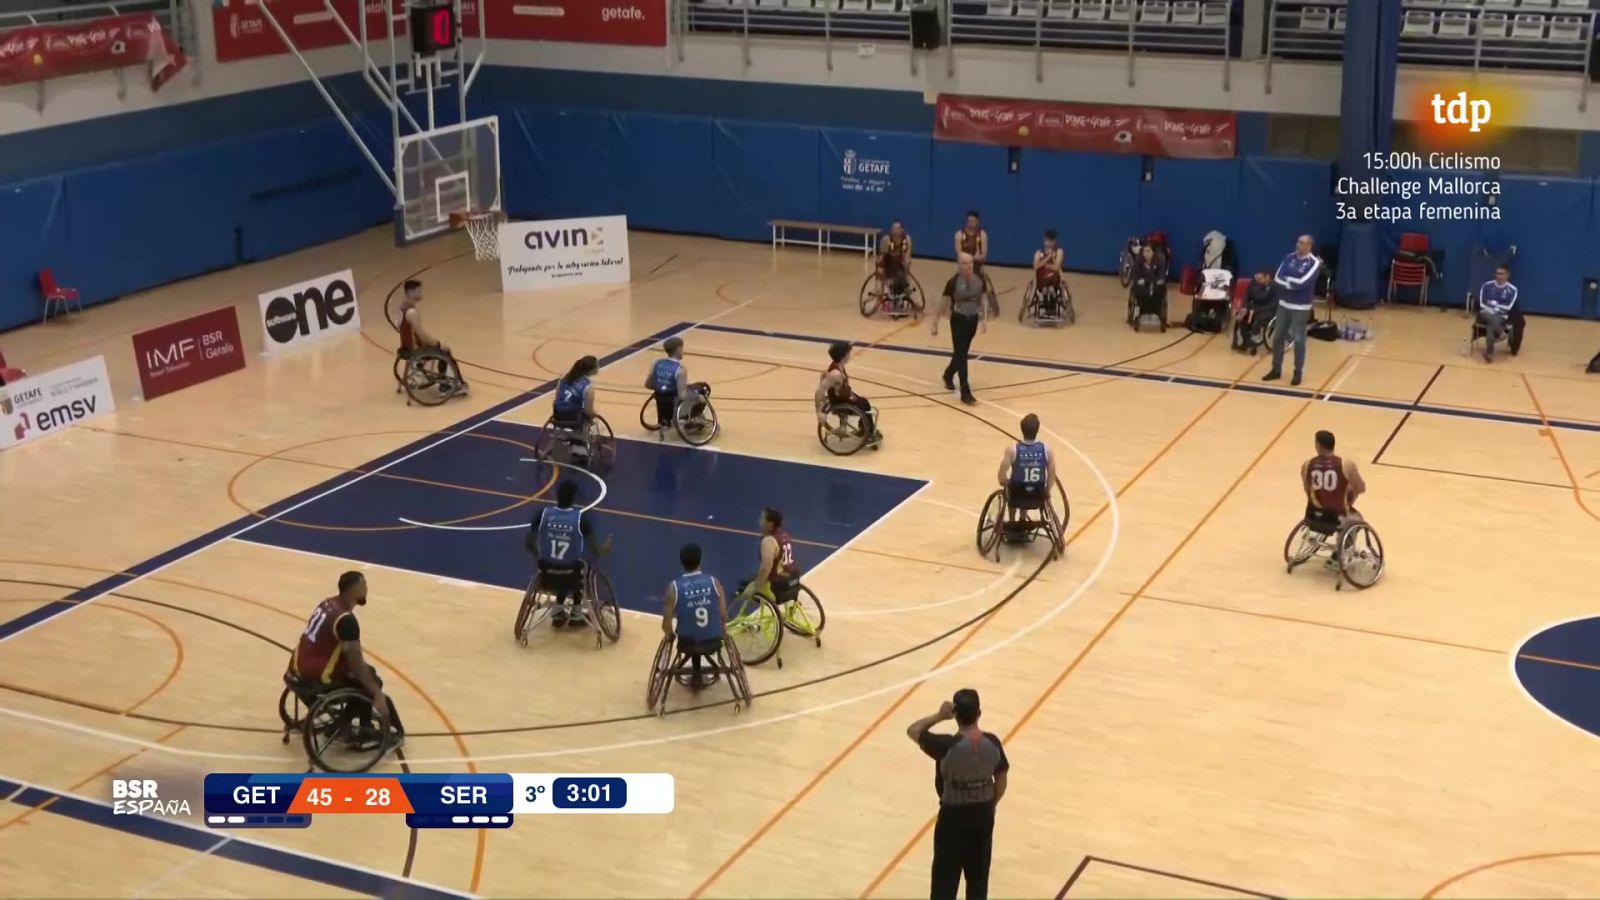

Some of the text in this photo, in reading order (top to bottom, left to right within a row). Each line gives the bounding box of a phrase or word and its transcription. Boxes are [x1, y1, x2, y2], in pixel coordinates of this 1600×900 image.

[858, 162, 890, 174] GETAFE
[266, 312, 296, 327] software
[202, 330, 223, 346] BSR
[146, 338, 195, 369] IMF
[14, 387, 42, 405] GETAFE
[36, 395, 96, 431] emsv
[1024, 467, 1041, 482] 16
[1311, 469, 1338, 492] 30
[550, 539, 570, 559] 17
[695, 607, 709, 627] 9
